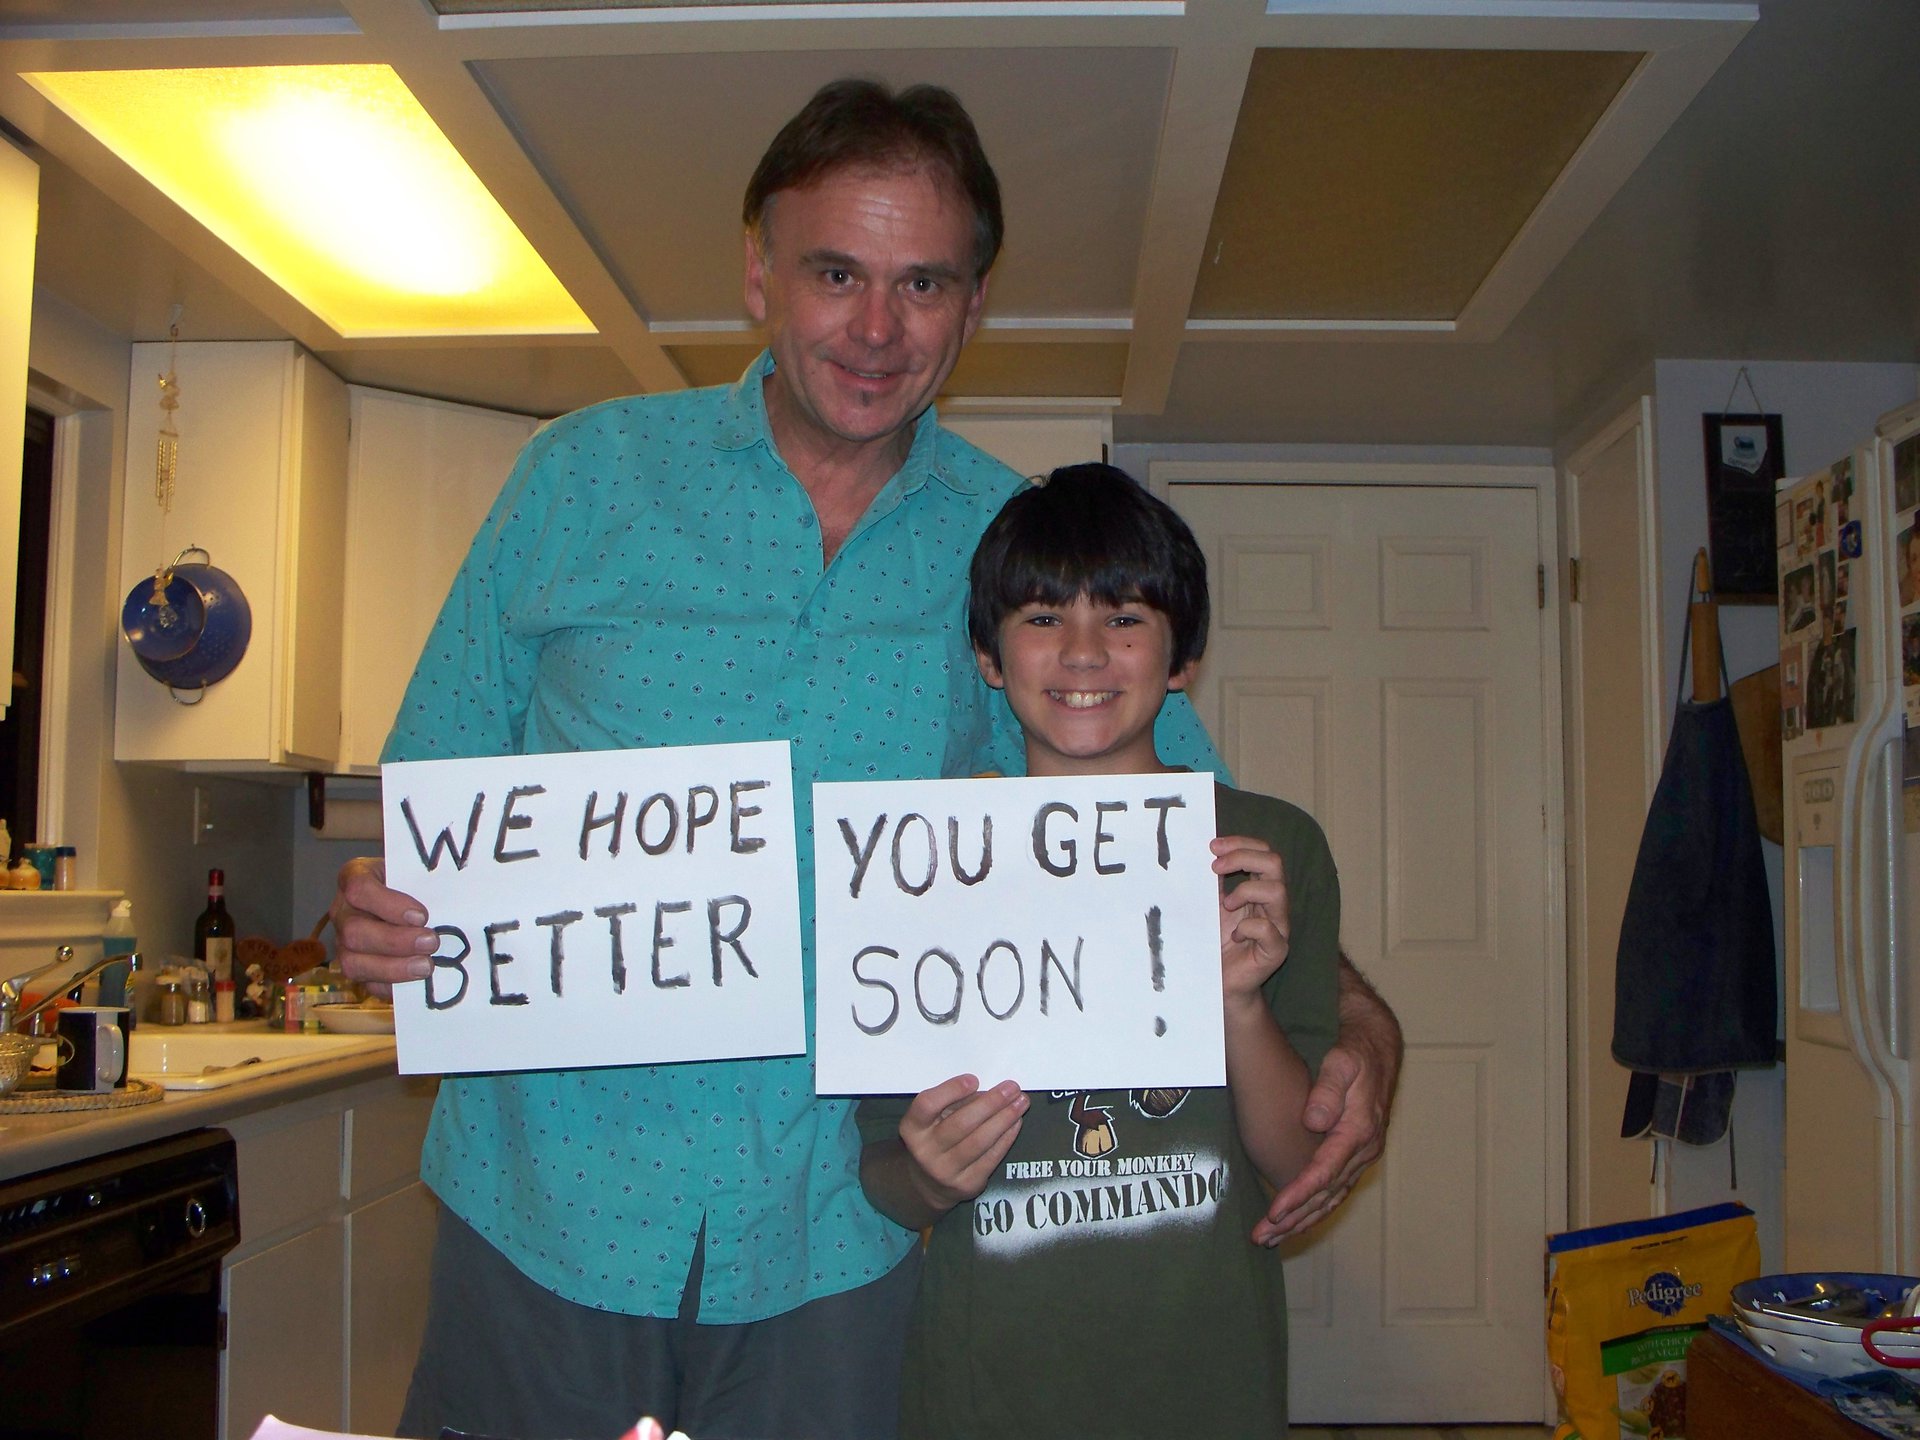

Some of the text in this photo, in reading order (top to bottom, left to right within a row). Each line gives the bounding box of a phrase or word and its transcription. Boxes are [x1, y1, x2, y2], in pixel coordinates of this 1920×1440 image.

[401, 780, 771, 872] WE HOPE
[837, 795, 1187, 899] YOU GET
[424, 894, 760, 1011] BETTER
[851, 904, 1168, 1038] SOON !
[1006, 1153, 1196, 1180] FREE YOUR MONKEY
[974, 1198, 1015, 1236] GO
[1627, 1281, 1703, 1308] Pedigree
